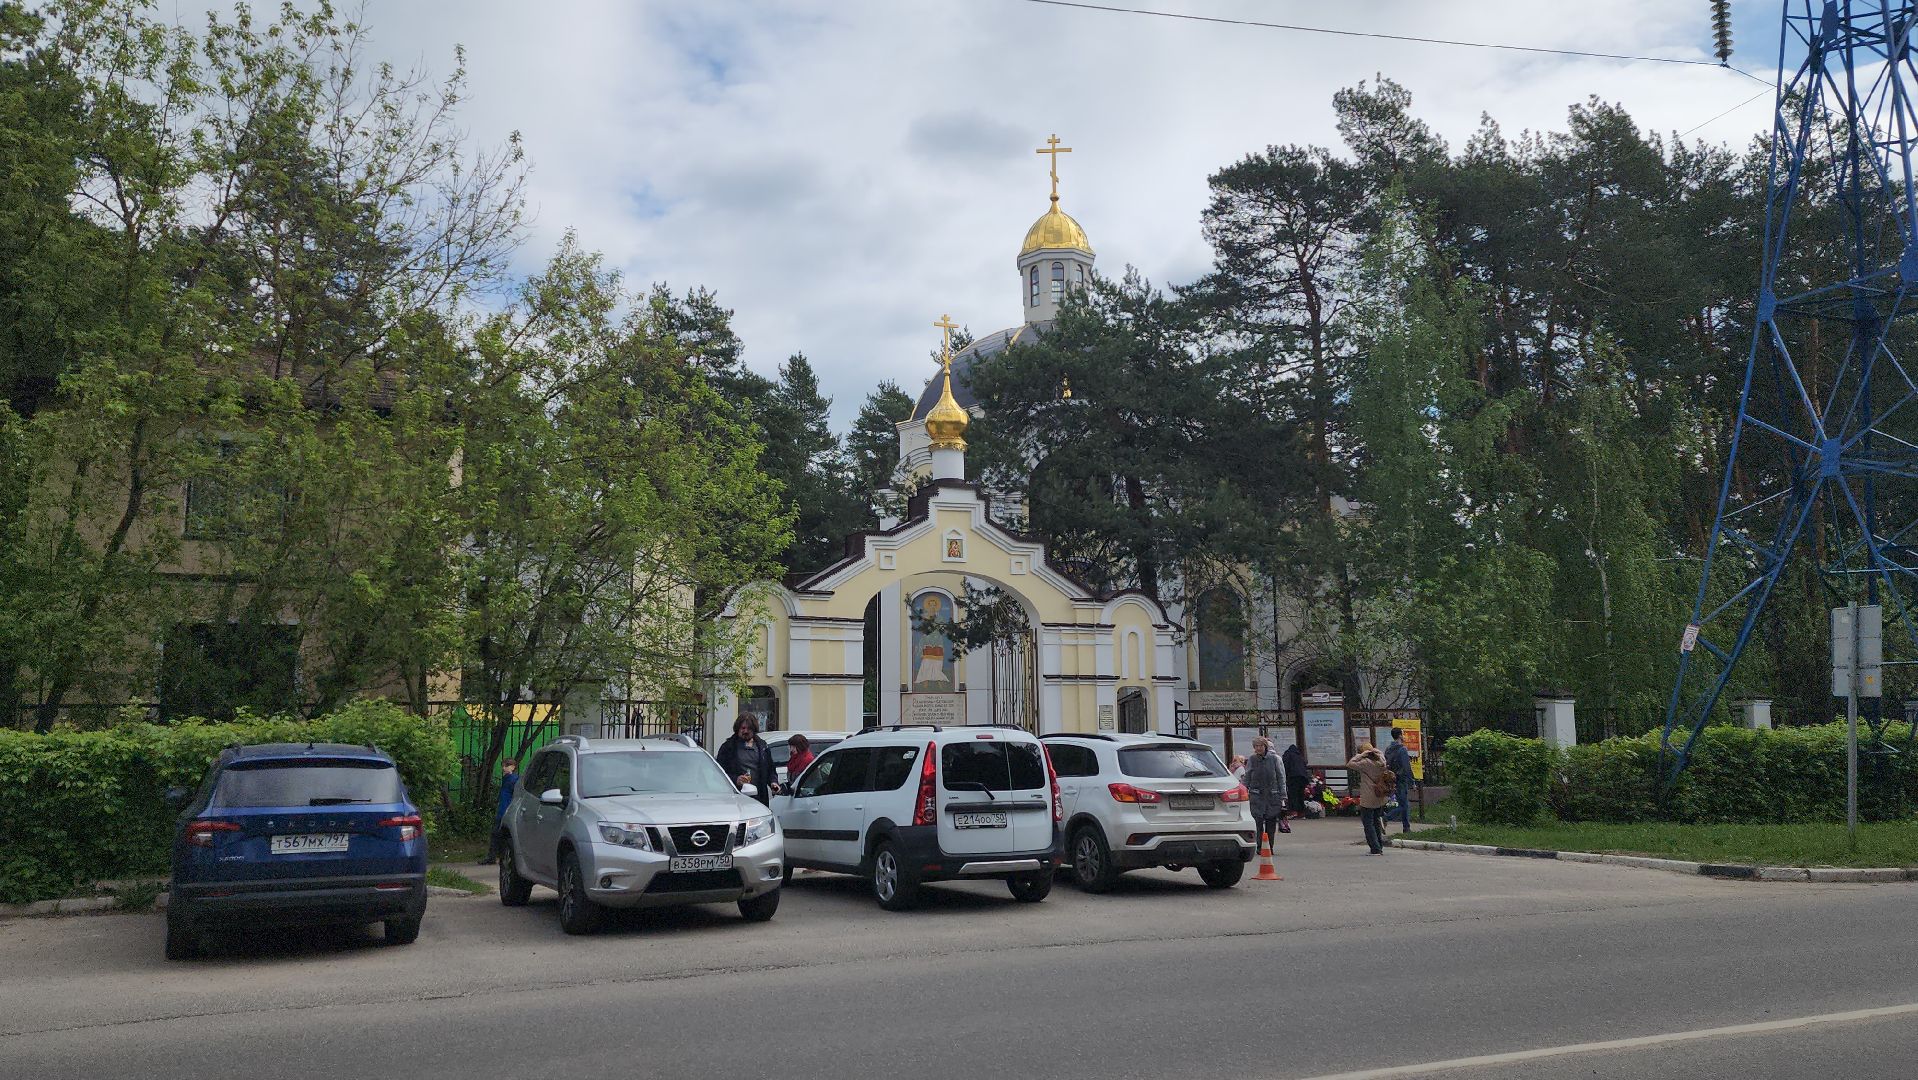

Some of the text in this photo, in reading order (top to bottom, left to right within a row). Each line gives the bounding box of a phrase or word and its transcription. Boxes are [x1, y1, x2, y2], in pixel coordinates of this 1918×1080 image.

[276, 833, 346, 849] Т567МХ 797
[674, 857, 714, 870] В358РМ
